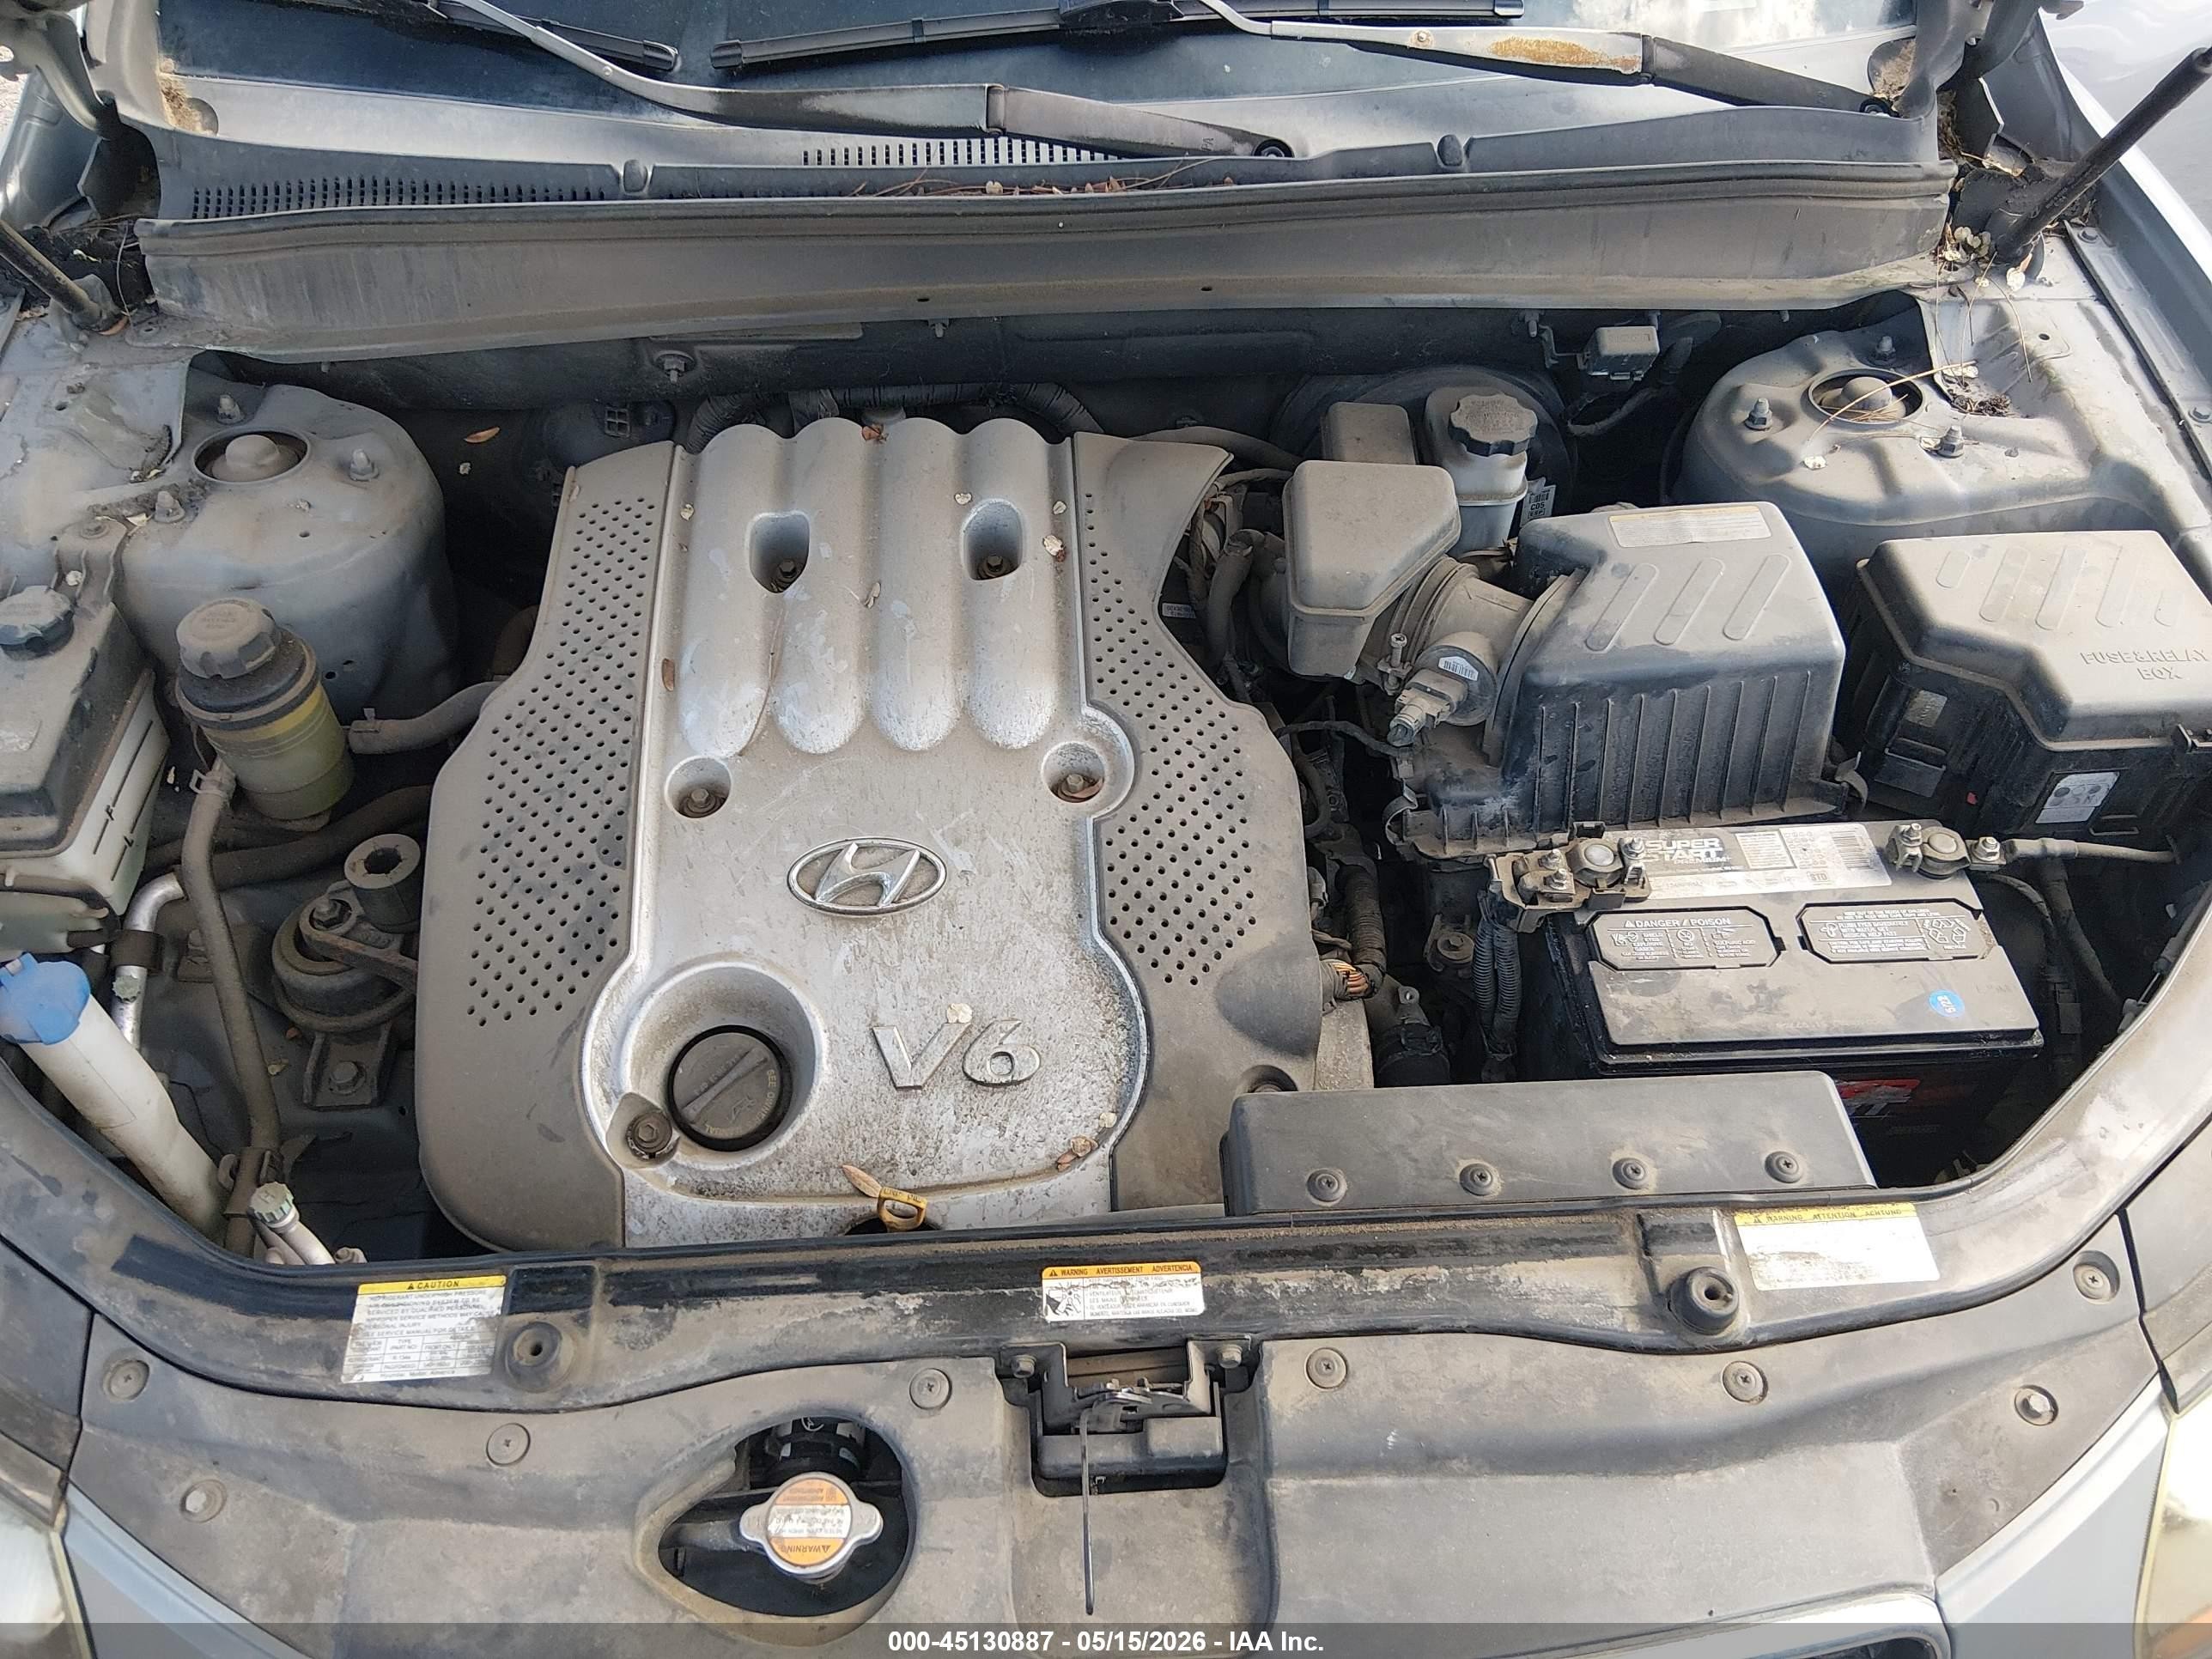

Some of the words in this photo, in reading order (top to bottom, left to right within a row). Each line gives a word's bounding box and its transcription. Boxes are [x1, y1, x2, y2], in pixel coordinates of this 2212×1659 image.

[2080, 649, 2209, 665] FUSE&RELAY
[2136, 666, 2185, 680] BOX
[105, 804, 114, 821] F
[124, 836, 134, 848] L
[1647, 836, 1722, 851] SUPER
[1644, 848, 1724, 863] START
[1635, 919, 1680, 928] DANGER
[1689, 917, 1732, 927] POISON
[872, 1016, 1042, 1090] V6
[767, 1069, 777, 1088] SEE
[1765, 1213, 1803, 1224] WARNING
[1061, 1267, 1088, 1276] WARNING
[1096, 1267, 1143, 1275] AVERTISSEMENT
[1152, 1264, 1193, 1273] ADVERTENCIA
[416, 1280, 460, 1290] CAUTION
[781, 1543, 823, 1553] WARNING
